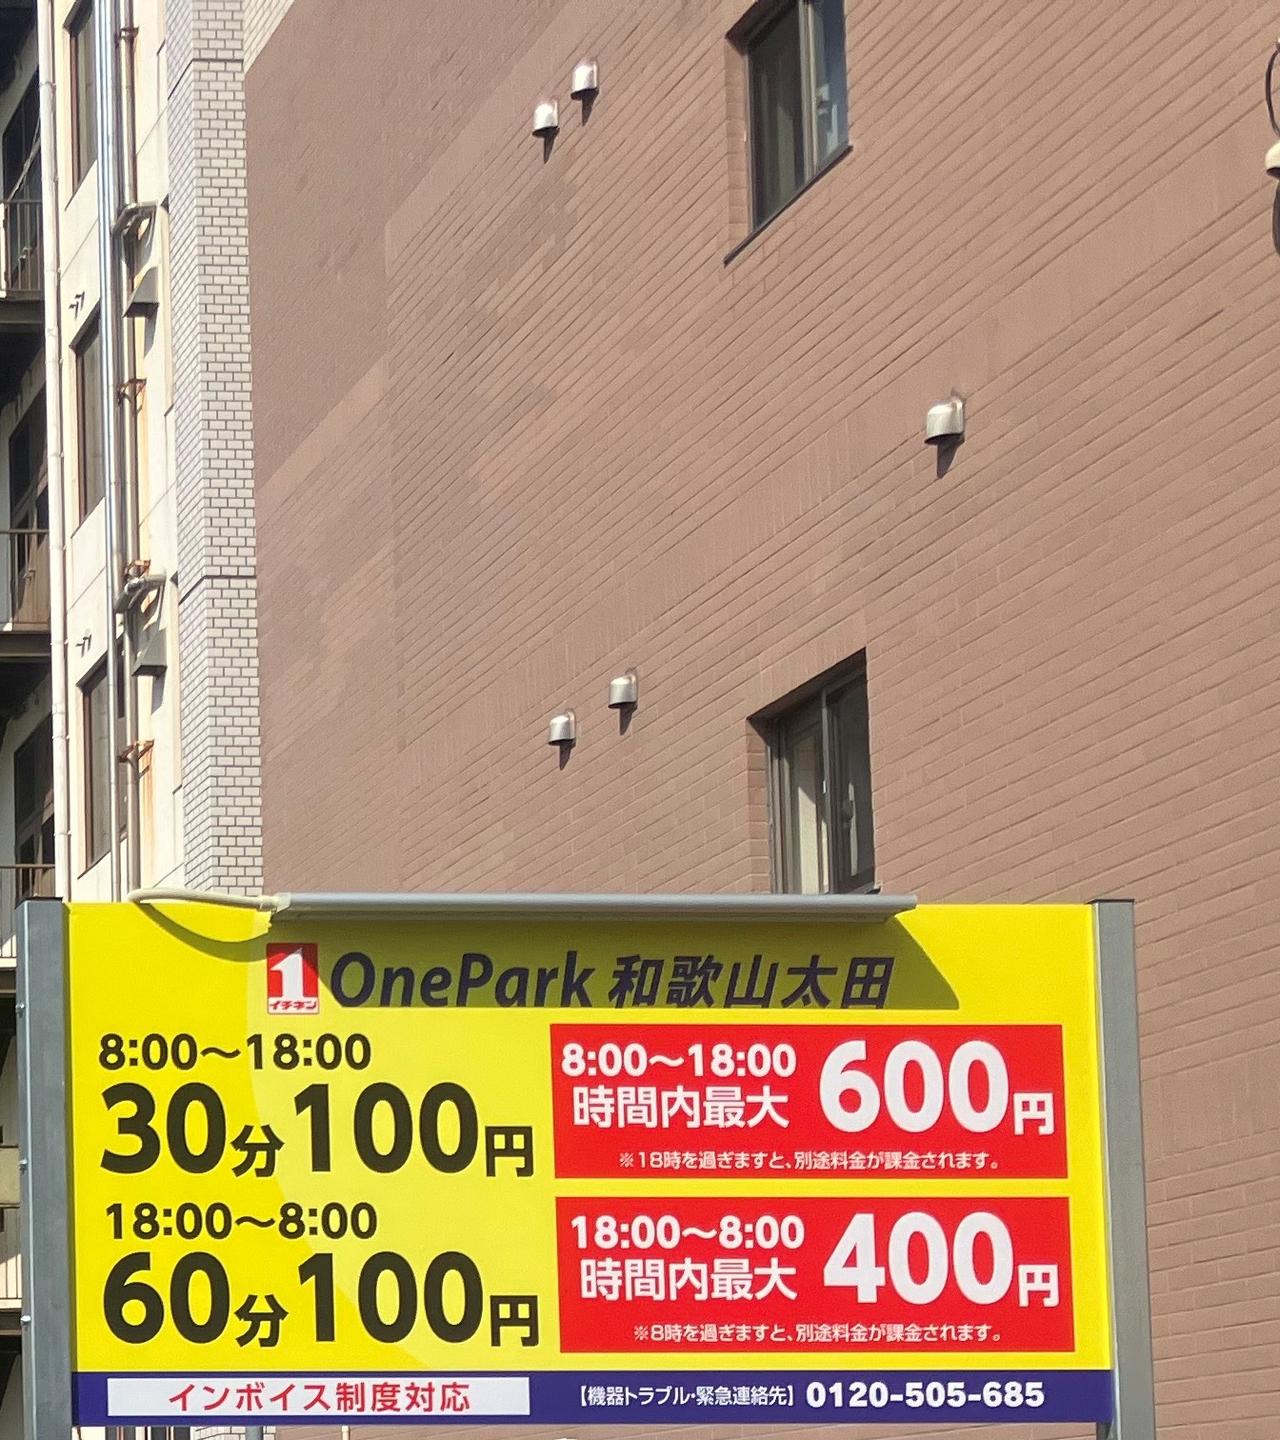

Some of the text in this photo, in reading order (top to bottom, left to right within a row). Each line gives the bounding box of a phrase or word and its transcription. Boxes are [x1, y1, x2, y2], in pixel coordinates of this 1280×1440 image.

[330, 950, 895, 1010] OnePark 和歌山太田
[572, 1086, 789, 1129] 時間内最大
[819, 1039, 1055, 1135] 600円
[579, 1257, 798, 1301] 時間内最大
[823, 1211, 1059, 1307] 400円
[168, 1382, 471, 1413] インボイス制度対応
[806, 1381, 1044, 1408] 0120-505-685
